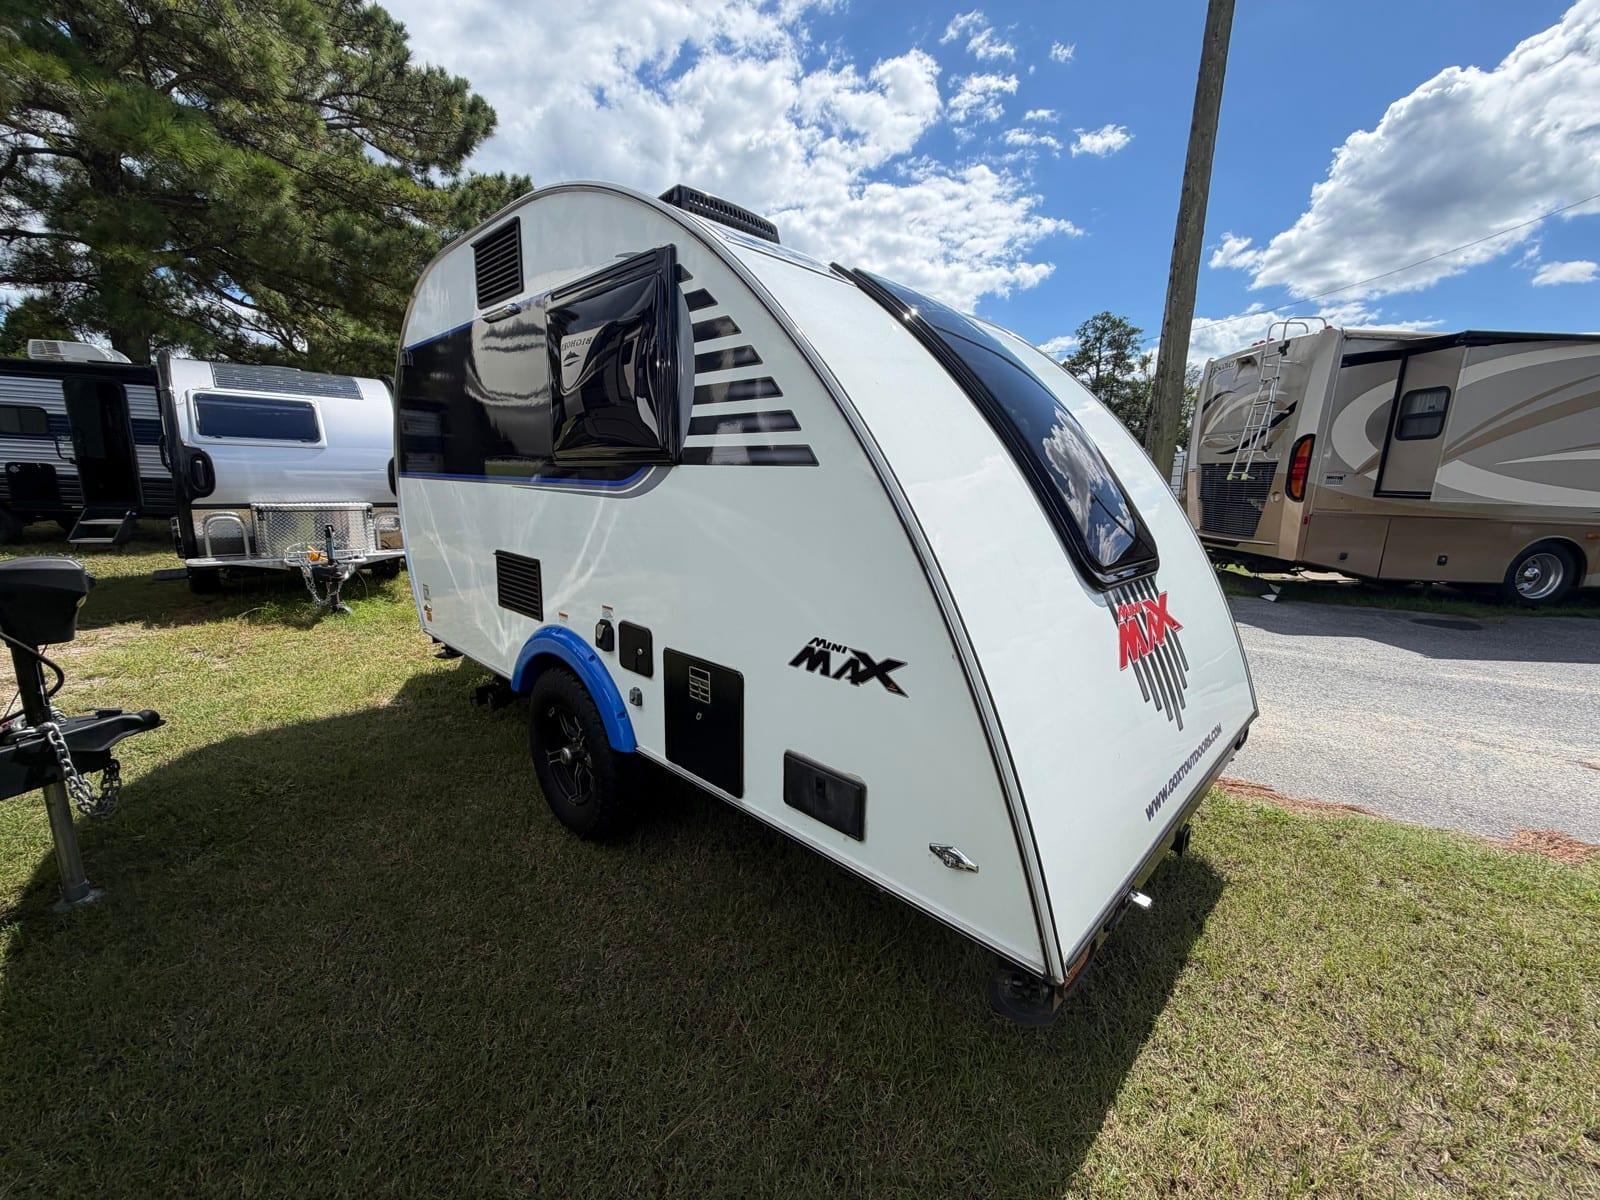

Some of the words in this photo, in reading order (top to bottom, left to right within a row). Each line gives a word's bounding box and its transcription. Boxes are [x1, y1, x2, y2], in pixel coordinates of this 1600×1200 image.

[1118, 601, 1142, 622] MINI
[1118, 591, 1184, 671] MAX
[788, 645, 909, 698] MAX
[808, 637, 848, 654] MINI
[1145, 722, 1223, 822] WWW.GOXTOUTDOORS.COM
